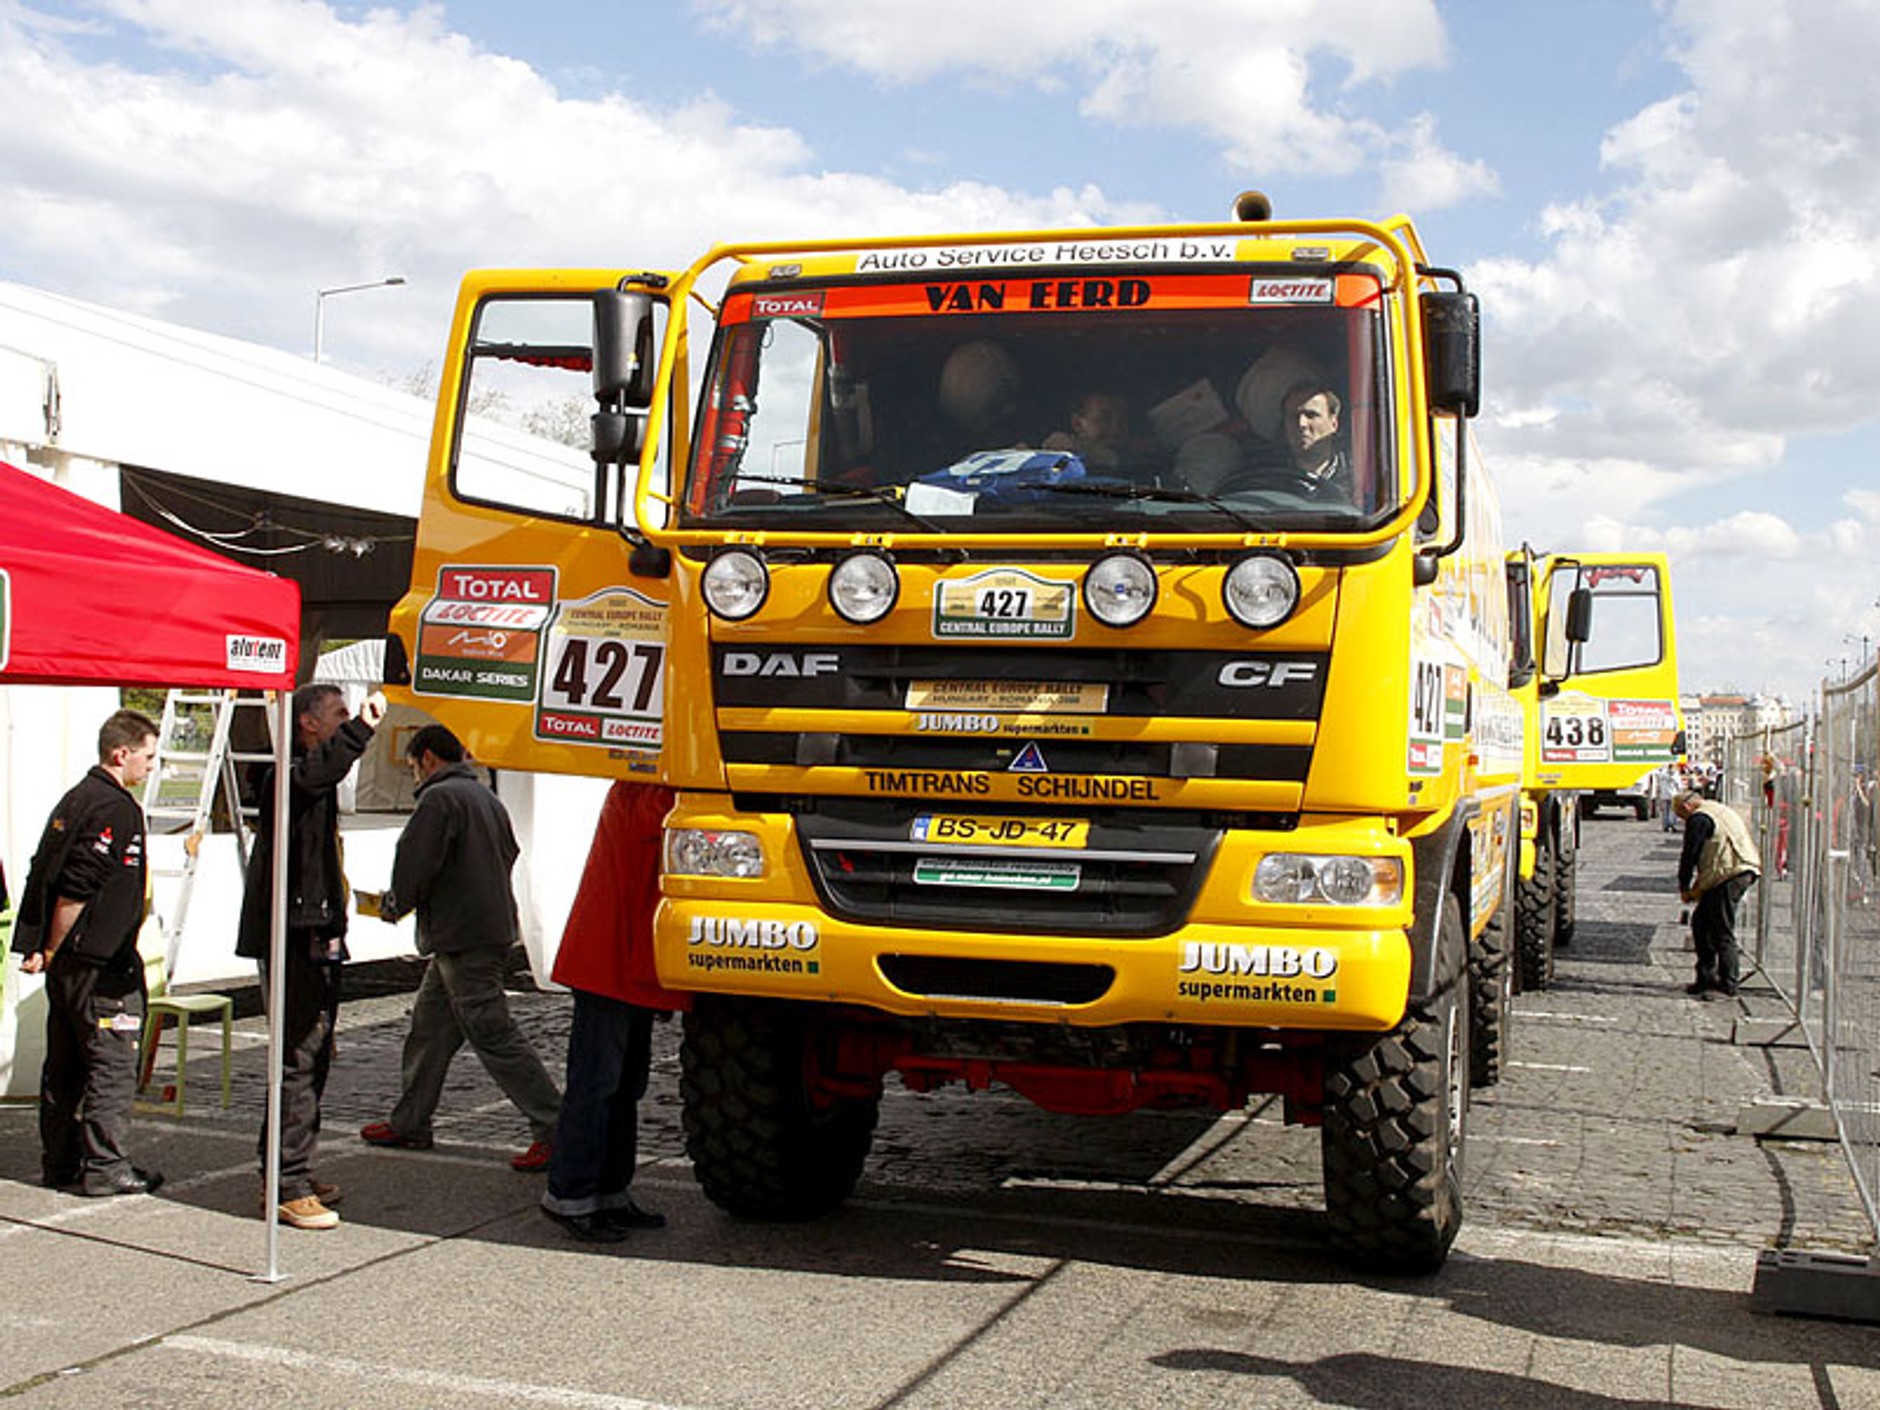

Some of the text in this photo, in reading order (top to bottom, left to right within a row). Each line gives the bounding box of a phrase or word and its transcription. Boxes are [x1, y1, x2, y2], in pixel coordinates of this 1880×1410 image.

[860, 241, 1232, 271] Auto Service Heesch b.v.
[924, 279, 1152, 312] VAN EERD
[1256, 282, 1328, 298] LOCTITE
[755, 298, 820, 313] TOTAL
[453, 574, 540, 600] TOTAL
[436, 603, 538, 625] LOCTITE
[981, 589, 1028, 618] 427
[940, 621, 1066, 634] CENTRAL EUROPE RALLY
[552, 638, 665, 712] 427
[722, 653, 839, 677] DAF
[1217, 661, 1317, 686] CF
[423, 667, 529, 688] DAKAR SERIES
[544, 716, 660, 740] TOTAL LOCTITE
[917, 713, 1079, 736] JUMBO supermarkten
[1546, 716, 1604, 746] 438
[865, 771, 1160, 801] TIMTRANS SCHIJNDEL
[937, 818, 1078, 841] BS-JD-47
[688, 916, 819, 952] JUMBO
[688, 952, 803, 973] supermarkten
[1178, 942, 1338, 979] JUMBO
[1178, 980, 1317, 1003] supermarkten
